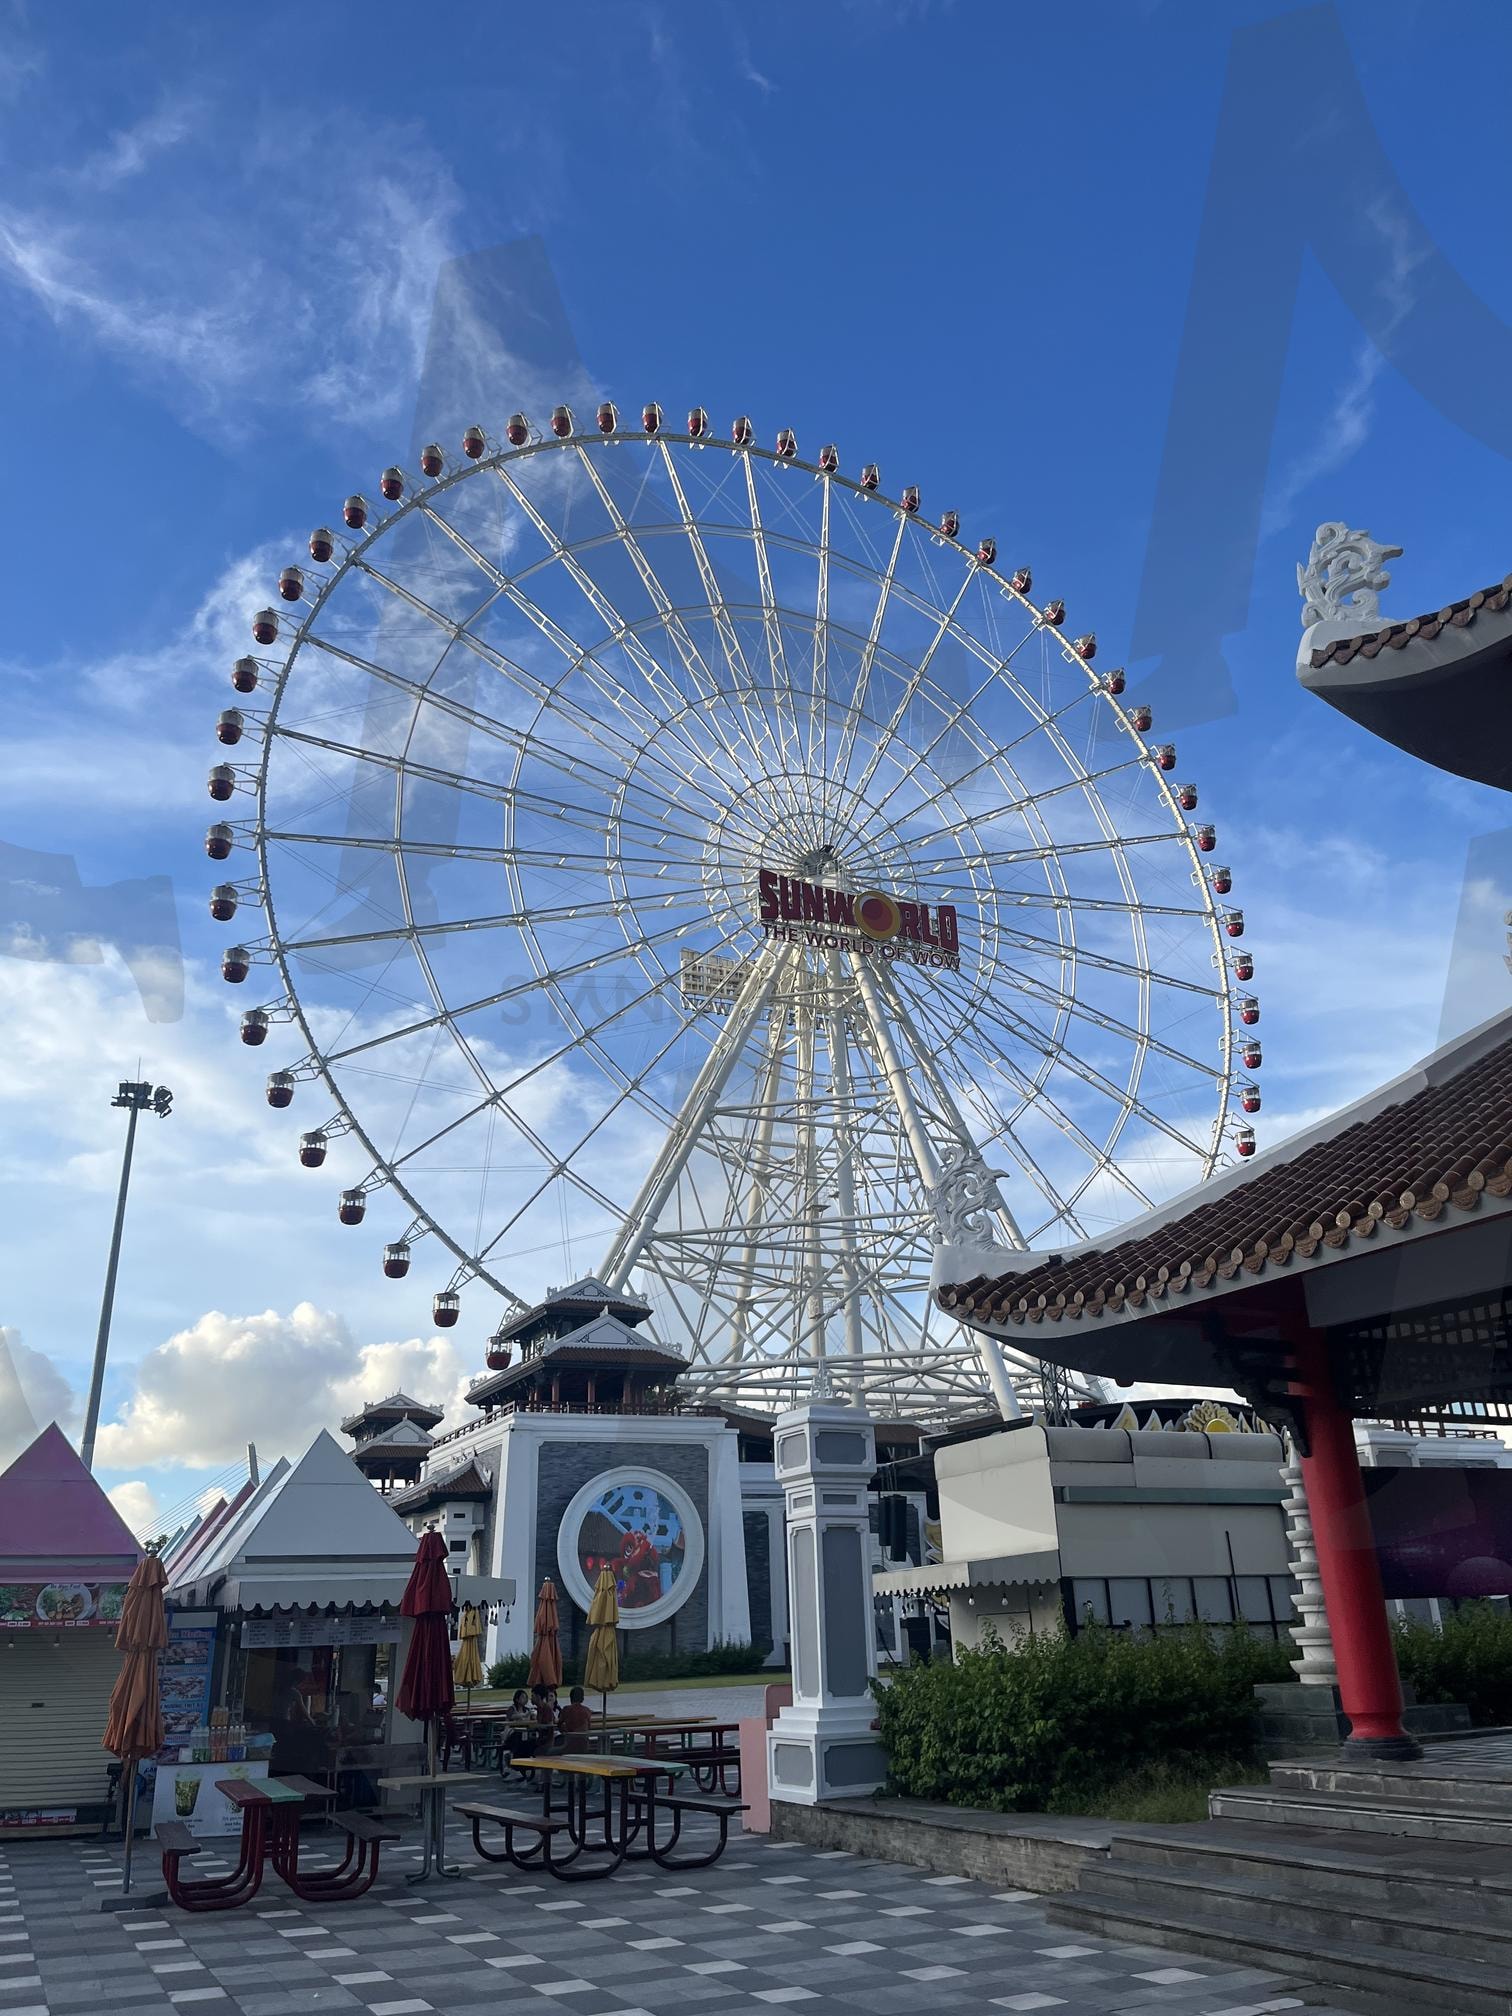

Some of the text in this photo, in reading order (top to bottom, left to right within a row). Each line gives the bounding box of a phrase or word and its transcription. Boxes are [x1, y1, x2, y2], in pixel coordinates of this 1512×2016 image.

[761, 923, 962, 971] THE WORLD OF WOW
